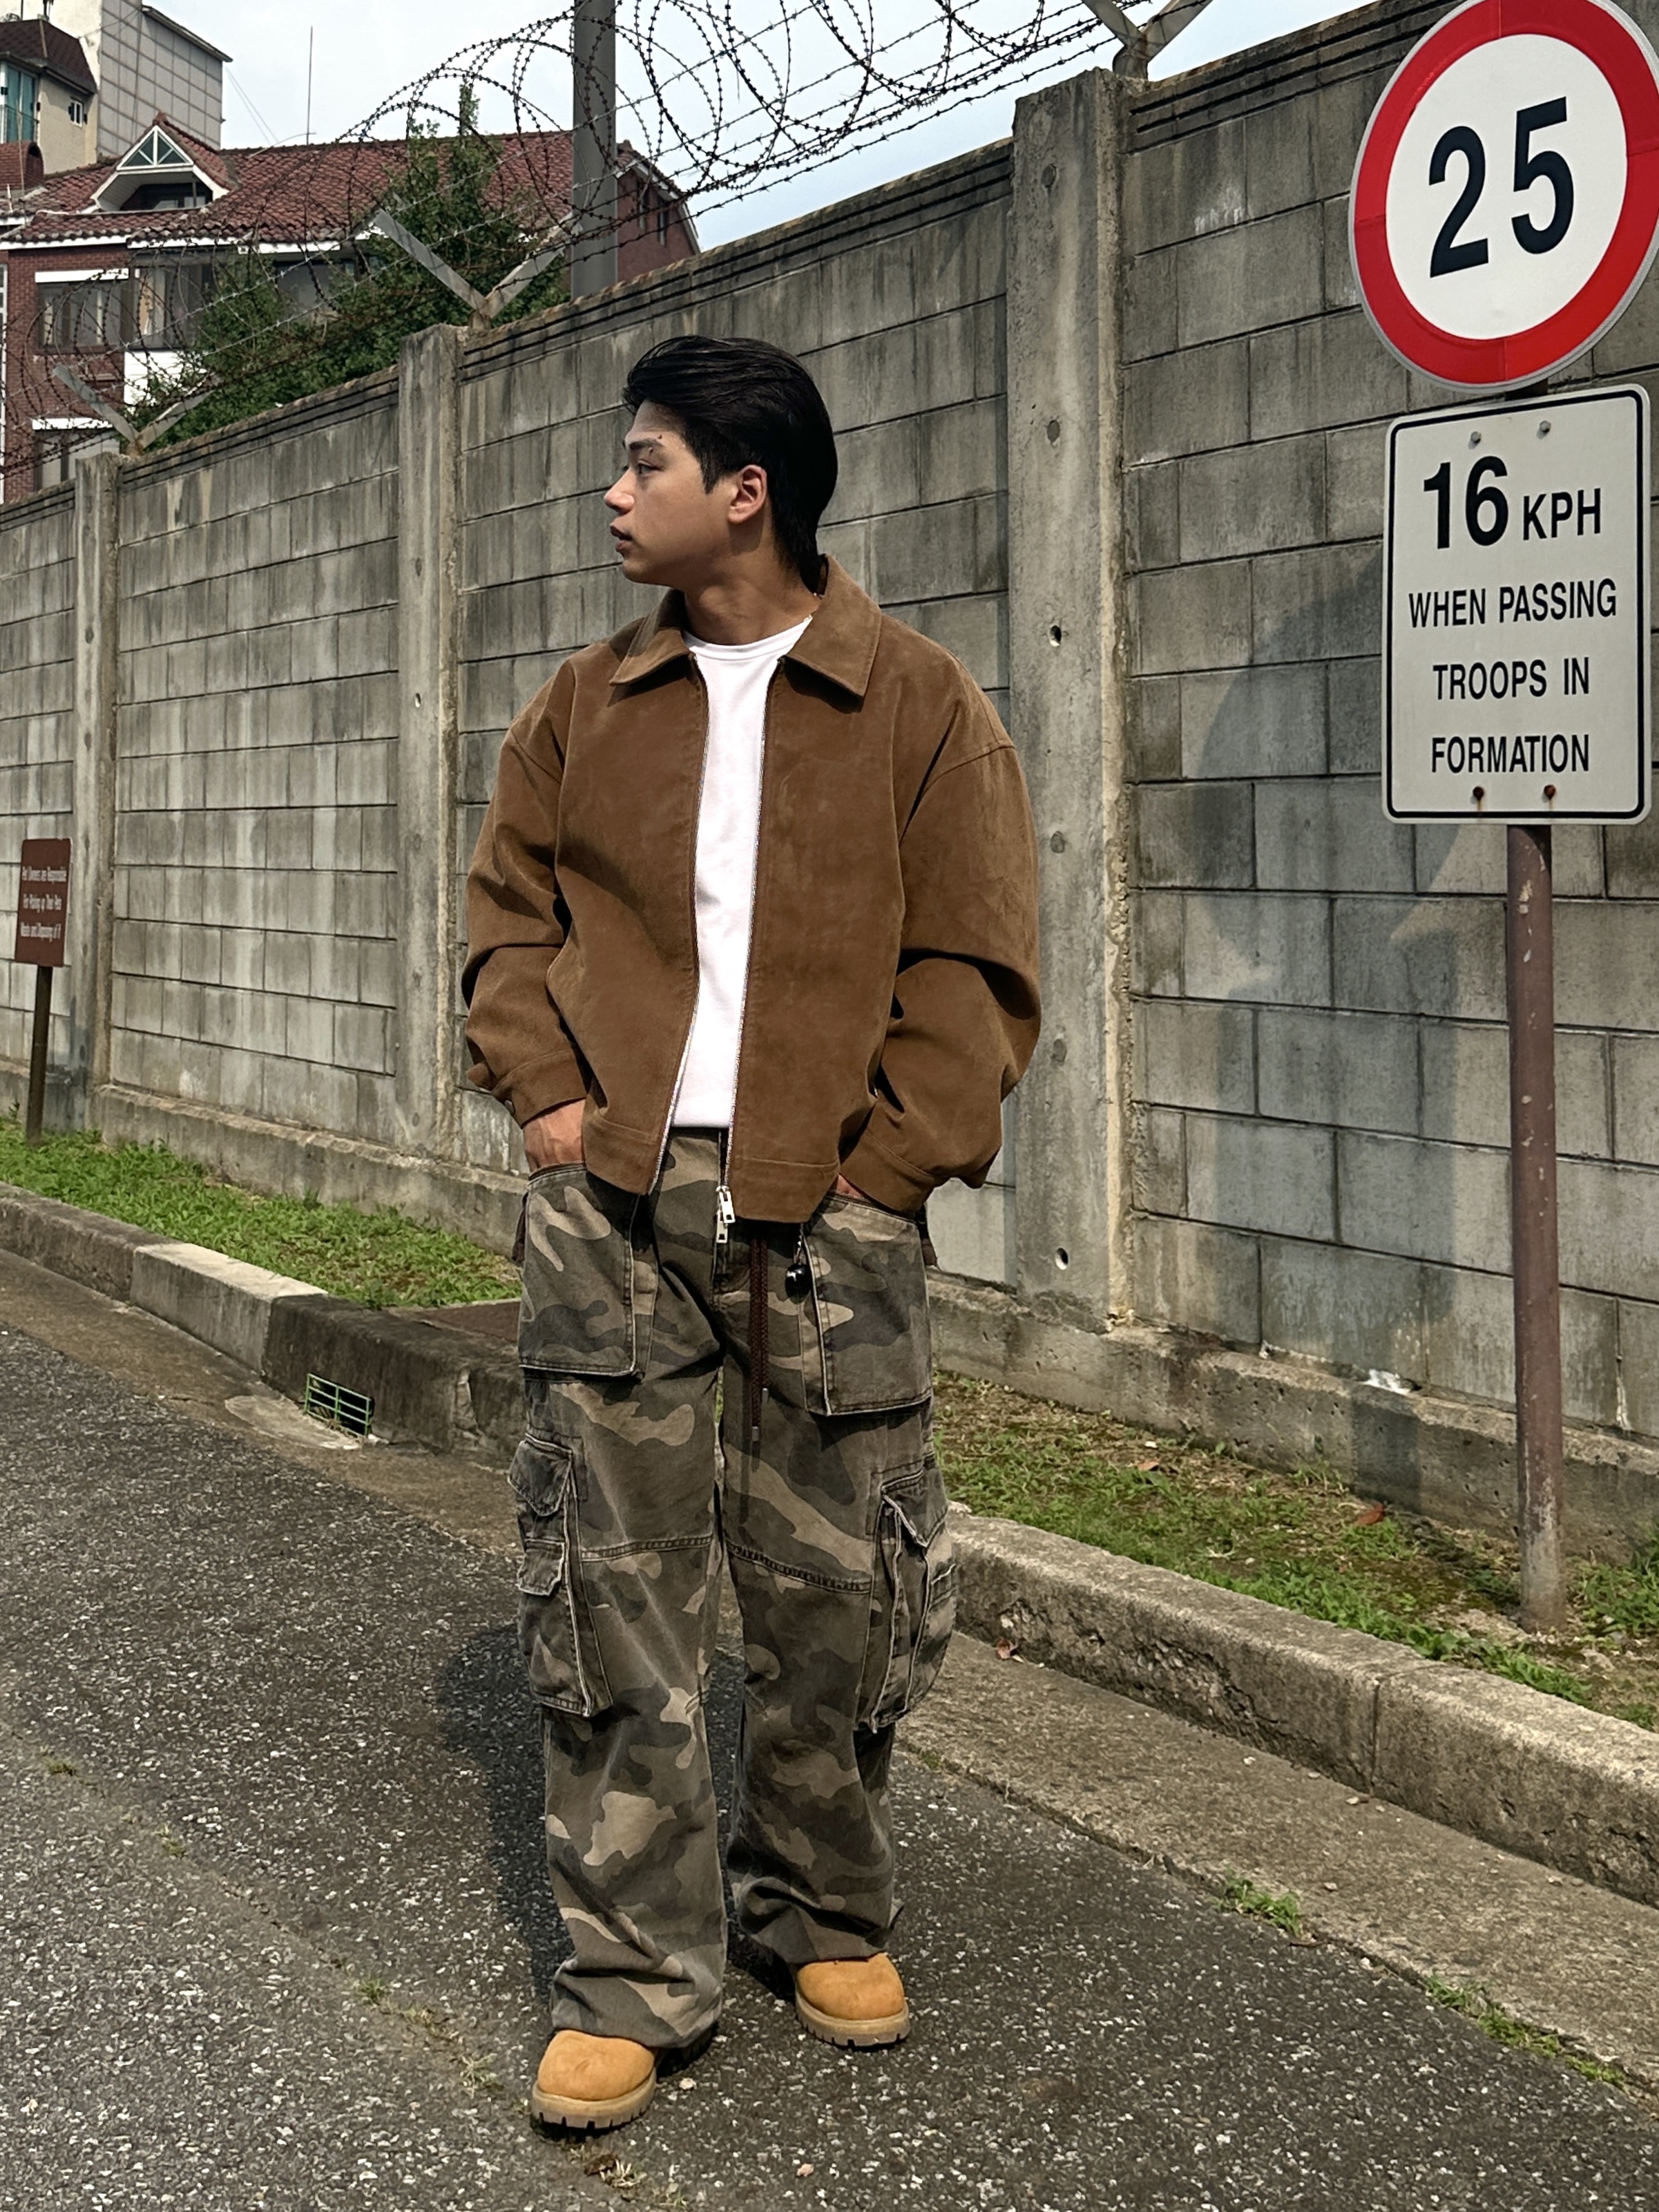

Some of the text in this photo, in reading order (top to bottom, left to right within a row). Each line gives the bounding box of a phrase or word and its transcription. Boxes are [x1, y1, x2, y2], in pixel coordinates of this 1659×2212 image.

[1428, 95, 1574, 278] 25
[1423, 455, 1602, 550] 16 KPH
[1408, 578, 1617, 628] WHEN PASSING
[1432, 656, 1590, 700] TROOPS IN
[1431, 734, 1590, 774] FORMATION
